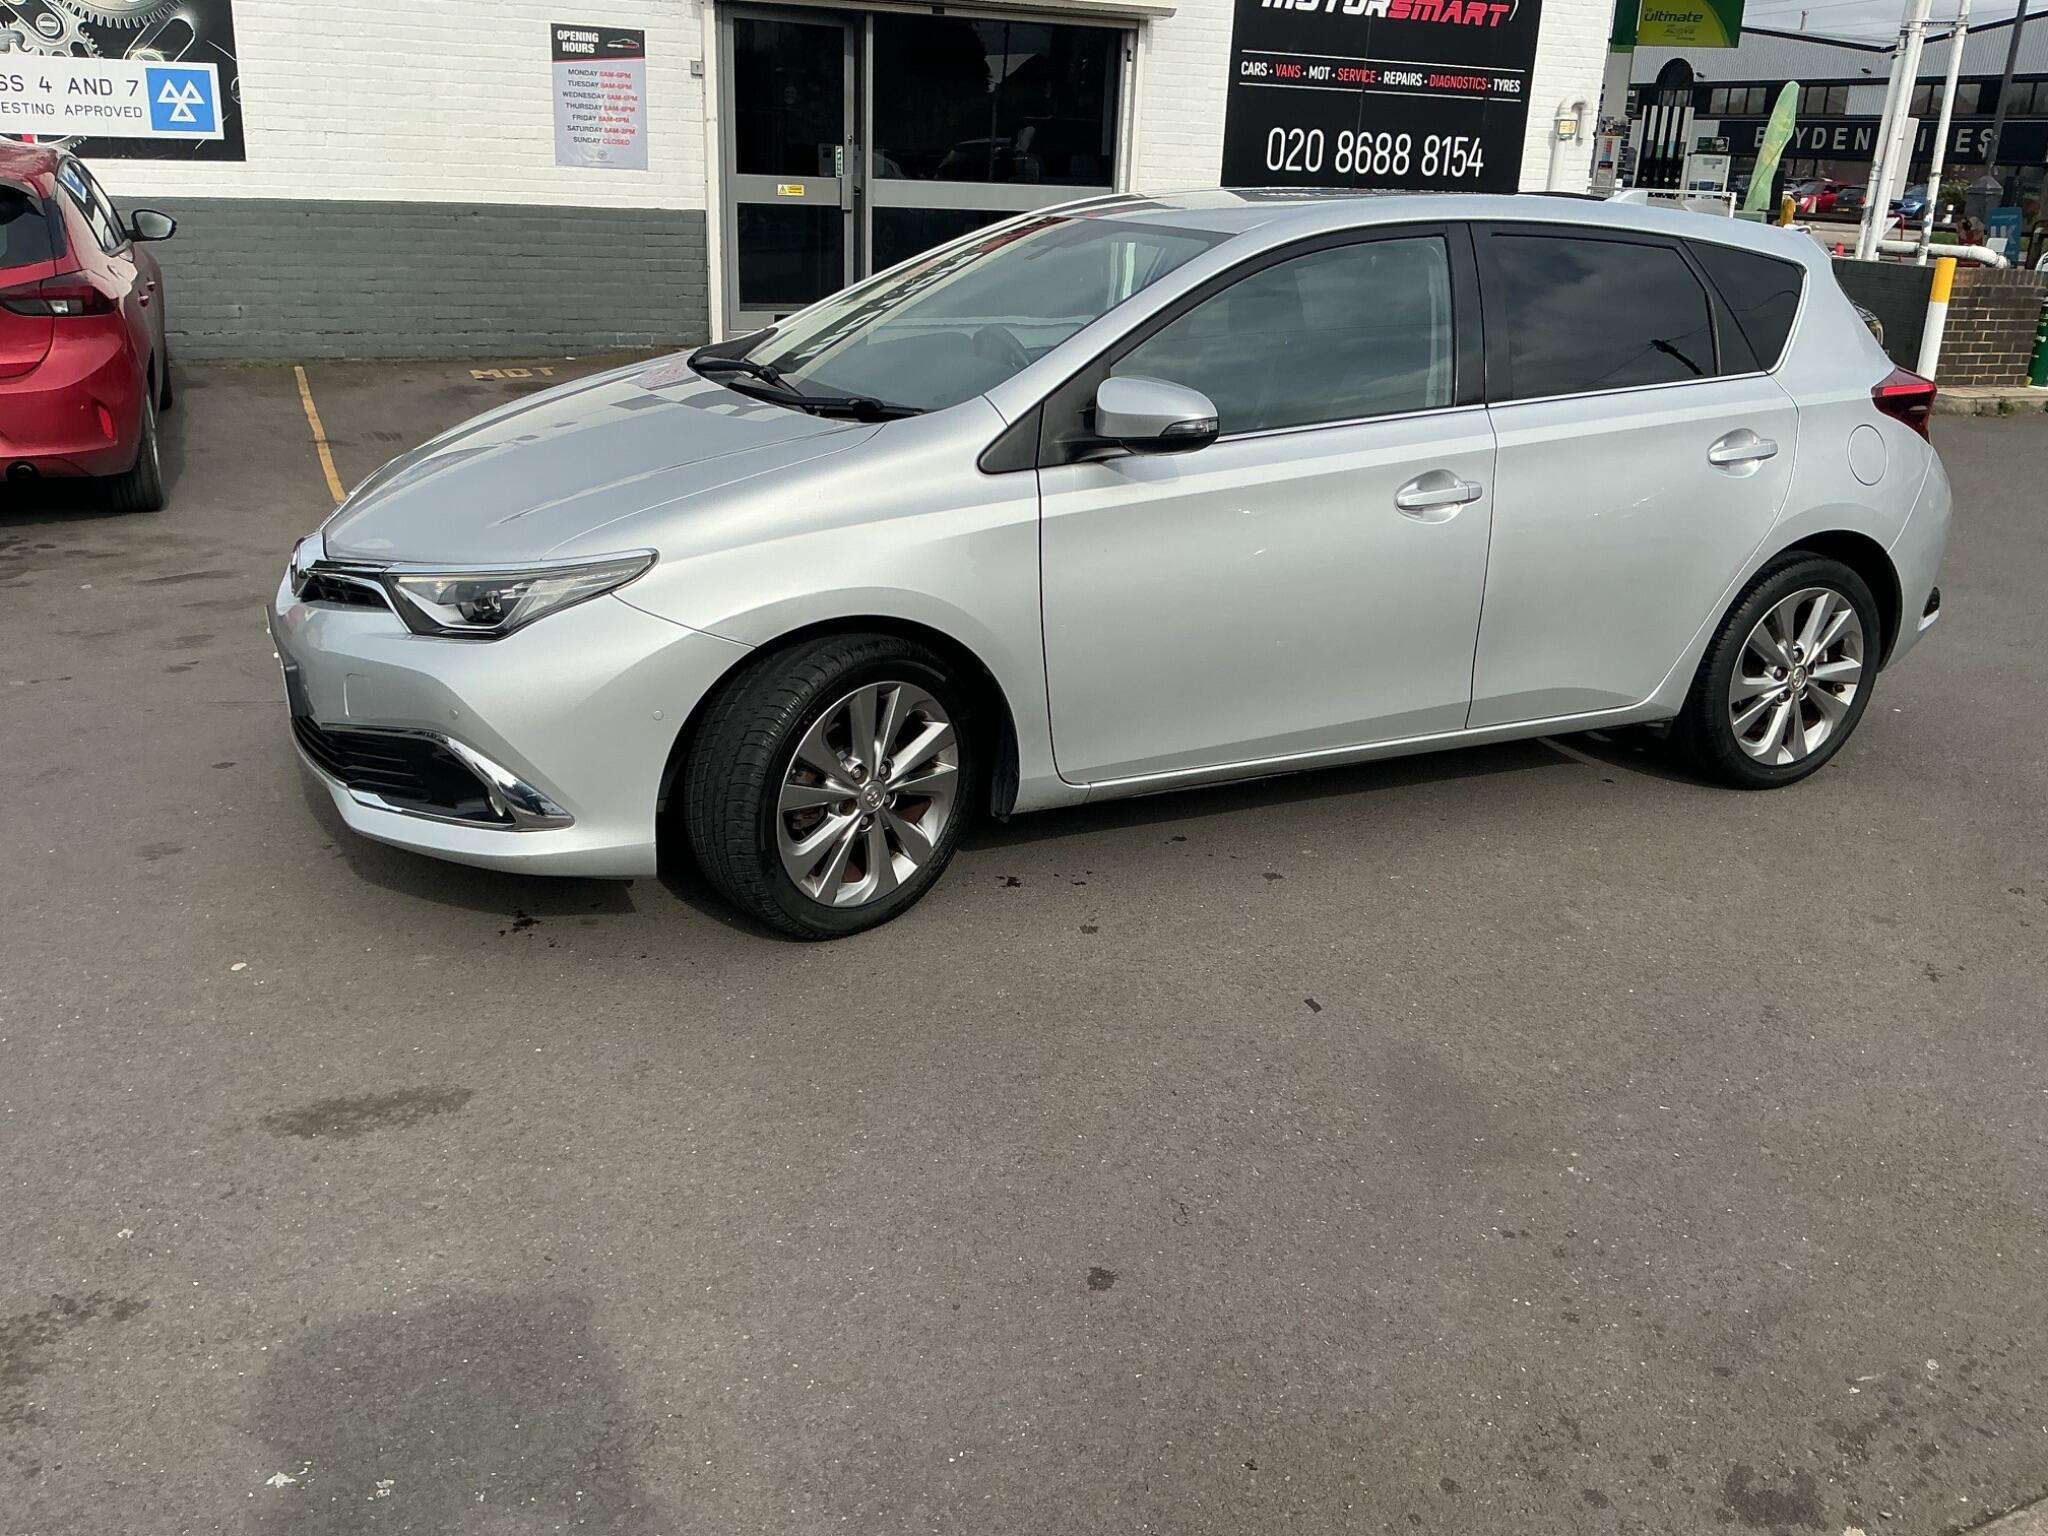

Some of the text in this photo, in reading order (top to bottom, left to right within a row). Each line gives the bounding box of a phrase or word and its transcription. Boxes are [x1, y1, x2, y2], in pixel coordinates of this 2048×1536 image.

[1645, 10, 1703, 23] ultimate
[557, 29, 599, 43] OPENING
[562, 41, 595, 54] HOURS
[568, 68, 598, 77] MONDAY
[1241, 61, 1521, 93] CARS VANS MOT SERVICE REPAIRS DIAGNOSTICS TYRES
[39, 76, 52, 93] 4
[67, 77, 113, 96] AND
[126, 80, 139, 97] 7
[568, 80, 599, 89] TUESDAY
[562, 91, 605, 100] WEDNESDAY
[64, 104, 143, 118] APPROVED
[566, 102, 602, 111] THURSDAY
[572, 114, 597, 122] FRIDAY
[567, 125, 602, 133] SATURDAY
[573, 136, 631, 146] SUNDAY CLOSED
[1754, 127, 1871, 151] BYDEN
[1266, 127, 1484, 178] 020 8688 8154
[469, 367, 554, 379] MOT
